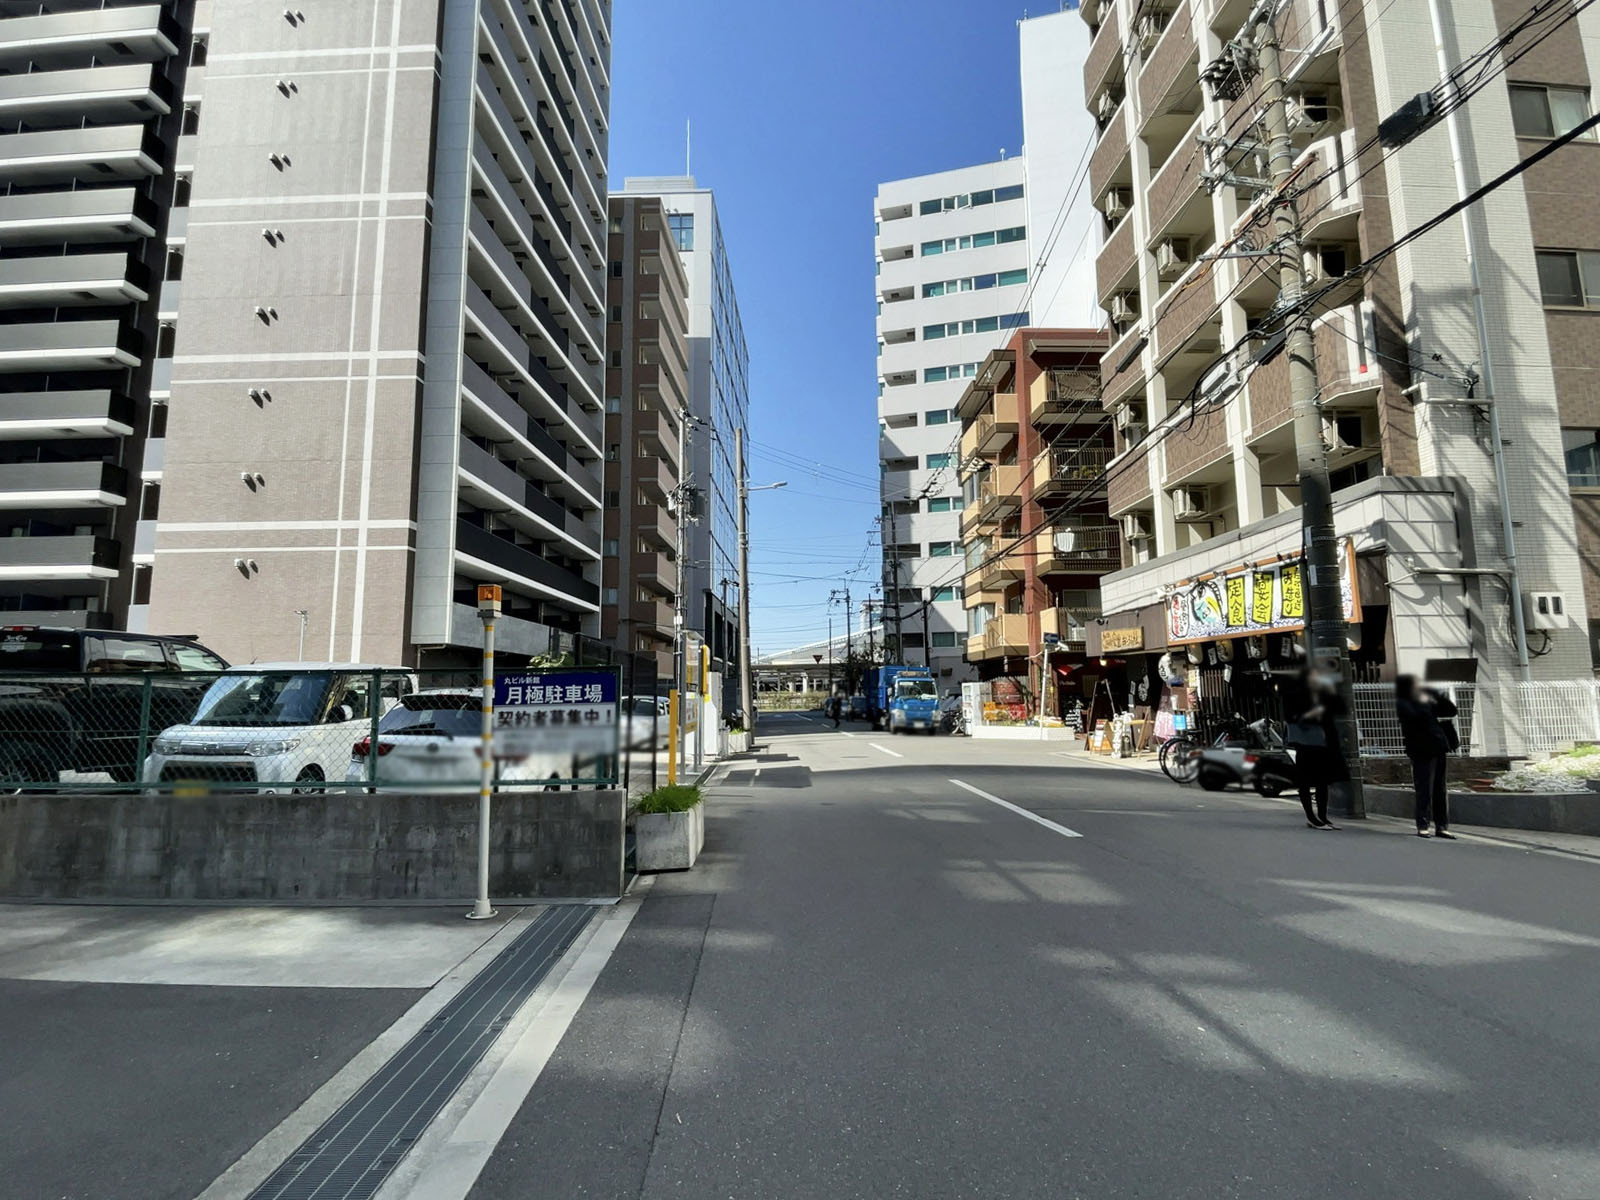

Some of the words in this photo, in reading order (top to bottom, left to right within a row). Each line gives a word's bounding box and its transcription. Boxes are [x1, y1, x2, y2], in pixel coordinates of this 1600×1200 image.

[506, 685, 603, 705] 月極駐車場
